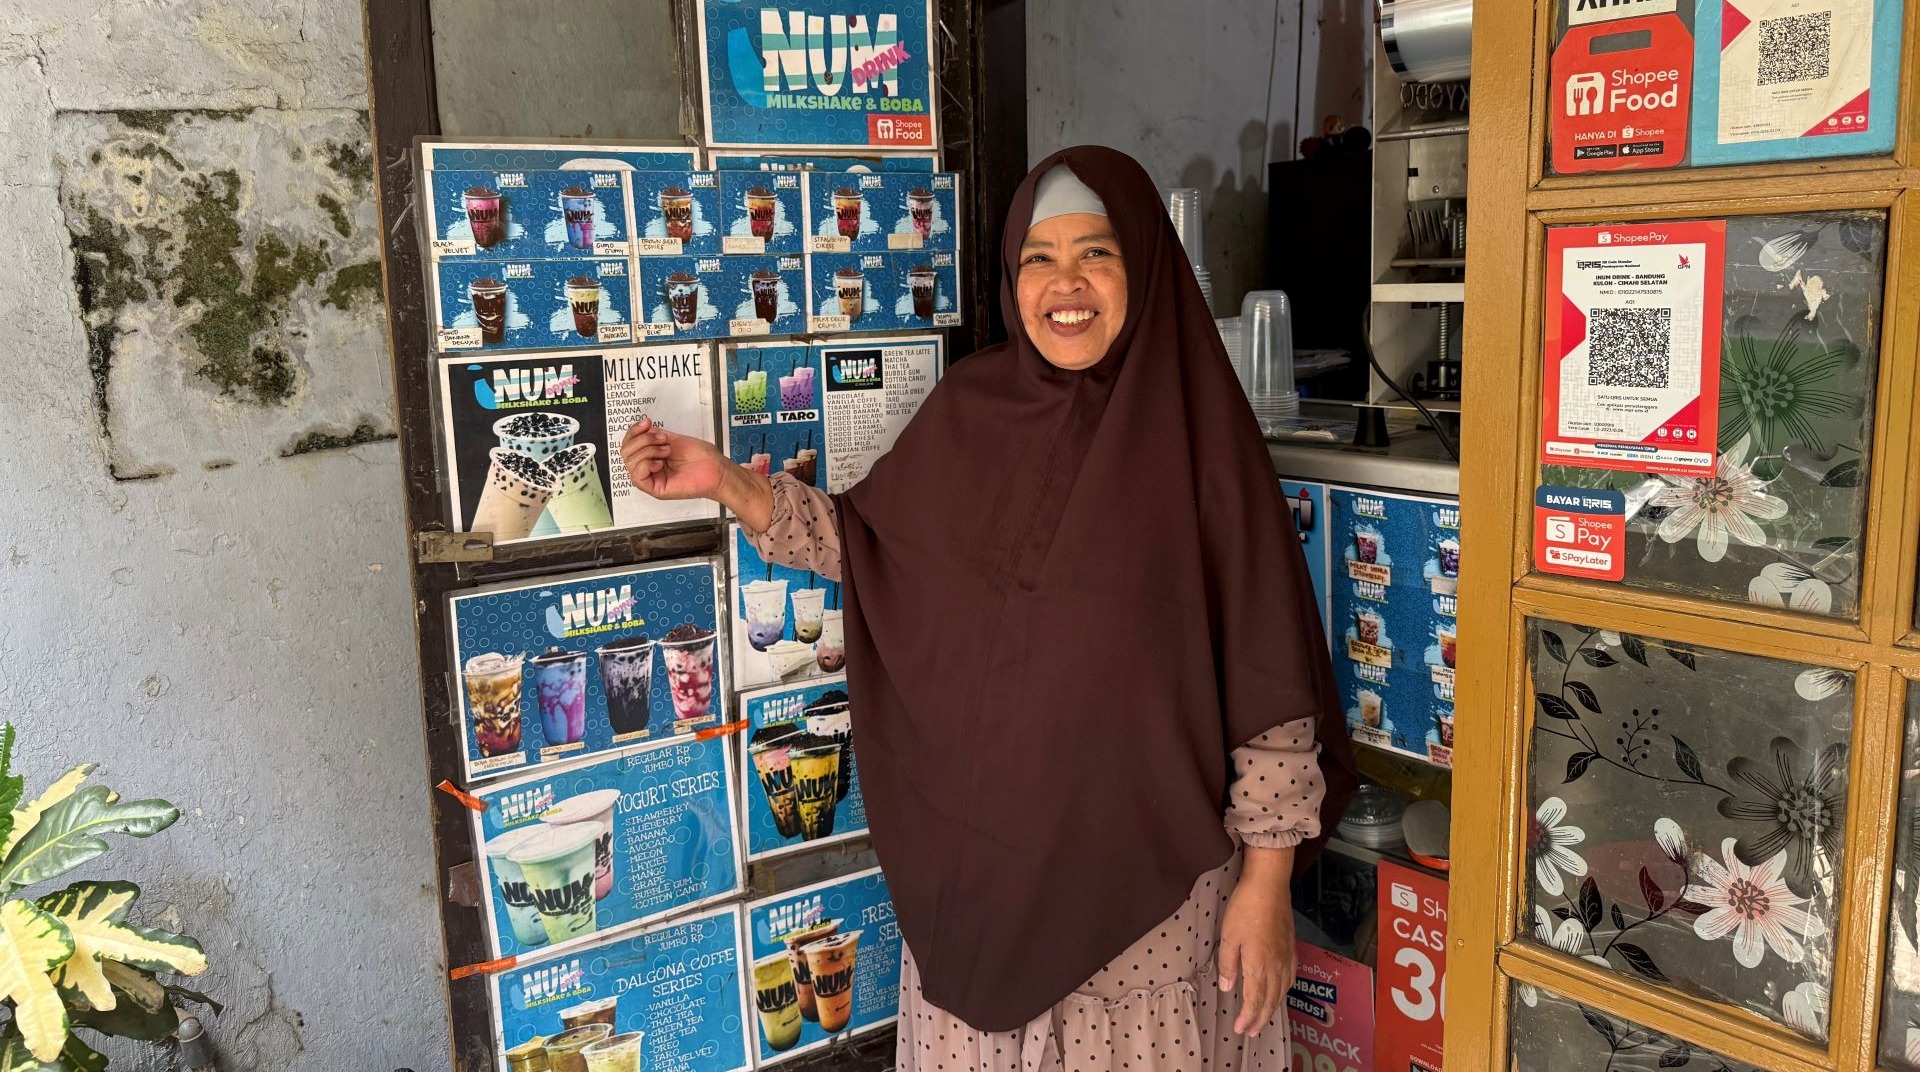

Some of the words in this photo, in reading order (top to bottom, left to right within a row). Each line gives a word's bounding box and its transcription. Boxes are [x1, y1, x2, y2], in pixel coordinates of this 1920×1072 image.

[850, 40, 911, 87] DRINK
[1611, 69, 1678, 88] Shopee
[767, 94, 862, 110] MILKSHAKE
[866, 98, 877, 110] &
[880, 97, 924, 112] BOBA
[1610, 84, 1678, 112] Food
[896, 119, 922, 129] Shopee
[896, 129, 922, 140] Food
[1575, 131, 1606, 141] HANYA
[1608, 130, 1616, 138] DI
[1636, 128, 1664, 137] Shopee
[1614, 232, 1668, 247] ShopeePay
[1576, 260, 1602, 270] QRIS
[604, 354, 702, 382] MILKSHAKE
[606, 382, 636, 390] LHYCEE
[562, 396, 588, 405] BOBA
[606, 391, 636, 399] LEMON
[608, 397, 656, 407] STRAWBERRY
[608, 407, 641, 415] BANANA
[780, 412, 815, 421] TARO
[608, 414, 648, 424] AVOCADO
[612, 473, 631, 481] GREE
[1546, 495, 1580, 506] BAYAR
[1582, 496, 1612, 511] QRIS
[1578, 518, 1612, 530] Shopee
[1577, 528, 1612, 551] Pay
[1562, 553, 1608, 566] SPayLater
[622, 620, 645, 629] BOBA
[627, 748, 672, 767] REGULAR
[676, 746, 689, 755] Rp
[642, 759, 673, 773] JUMBO
[677, 756, 690, 766] Rp
[616, 784, 668, 814] YOGURT
[672, 771, 719, 798] SERIES
[674, 877, 693, 888] GUM
[675, 881, 708, 897] CANDY
[862, 901, 896, 926] FRES
[644, 926, 687, 944] REGULAR
[690, 924, 702, 934] Rp
[658, 936, 688, 951] JUMBO
[691, 933, 704, 944] Rp
[616, 962, 686, 993] DALGONA
[690, 948, 734, 971] COFFE
[653, 972, 703, 998] SERIES
[676, 1010, 694, 1020] TEA
[686, 1016, 704, 1026] TEA
[679, 1026, 698, 1037] TEA
[678, 1046, 713, 1062] VELVET
